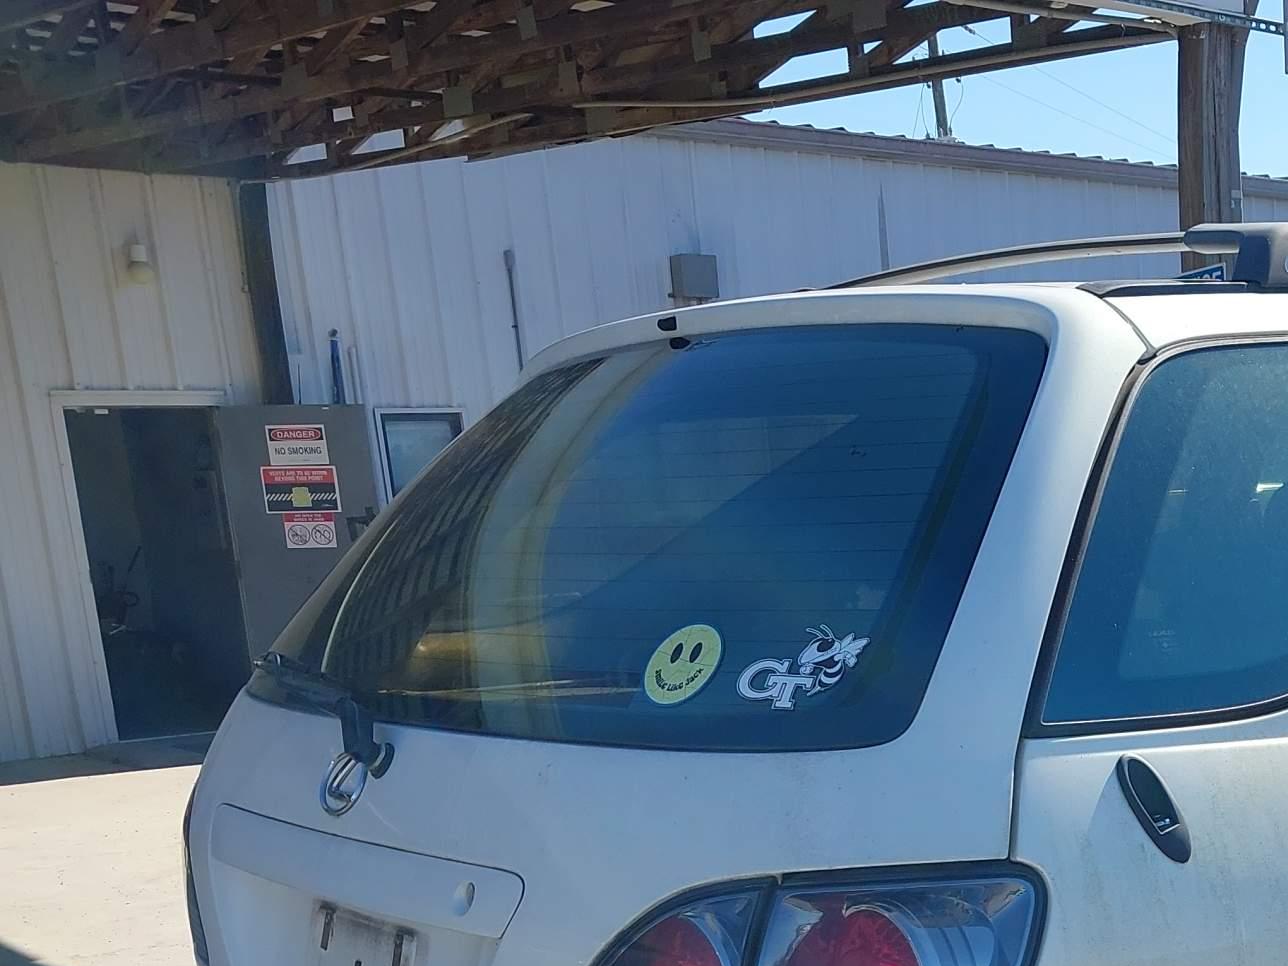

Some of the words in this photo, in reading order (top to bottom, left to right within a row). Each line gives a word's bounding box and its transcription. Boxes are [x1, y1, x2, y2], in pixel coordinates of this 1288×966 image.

[276, 430, 316, 439] DANGER
[274, 447, 286, 455] NO
[287, 446, 322, 455] SMOKING
[737, 658, 816, 710] GT
